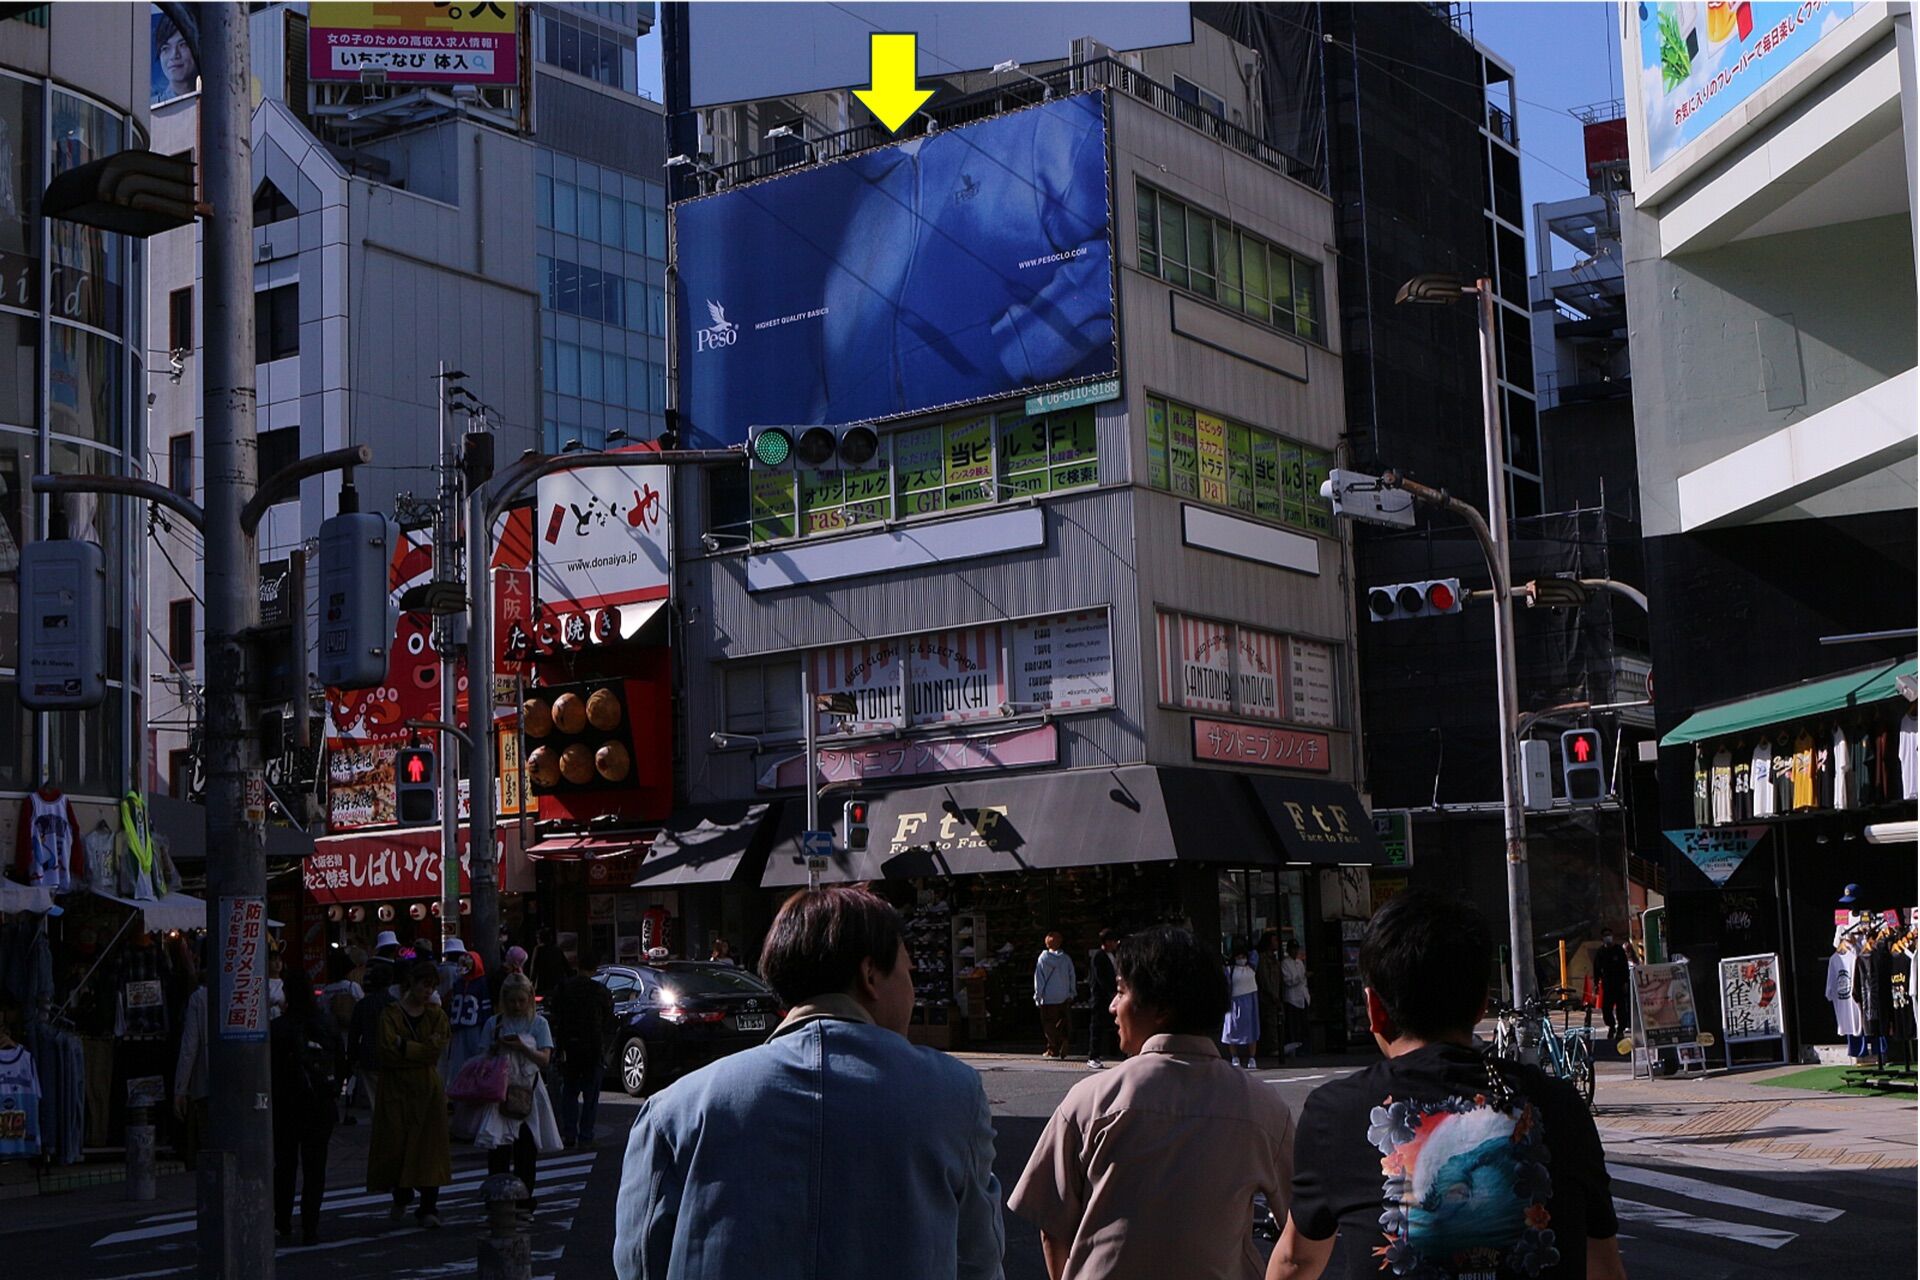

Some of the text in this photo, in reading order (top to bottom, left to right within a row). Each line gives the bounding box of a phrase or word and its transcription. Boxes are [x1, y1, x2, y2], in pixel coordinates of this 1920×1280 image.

[434, 56, 470, 73] 体入
[697, 328, 738, 353] Peso
[568, 552, 638, 573] www.donaiya.jp
[866, 645, 916, 667] CLOTHIG
[1208, 725, 1318, 764] サントニブンノイチ
[957, 837, 999, 850] Face
[224, 899, 246, 973] 安心を見守る
[228, 904, 262, 1026] 防犯カメラ天国
[247, 977, 263, 1029] アメリカ村
